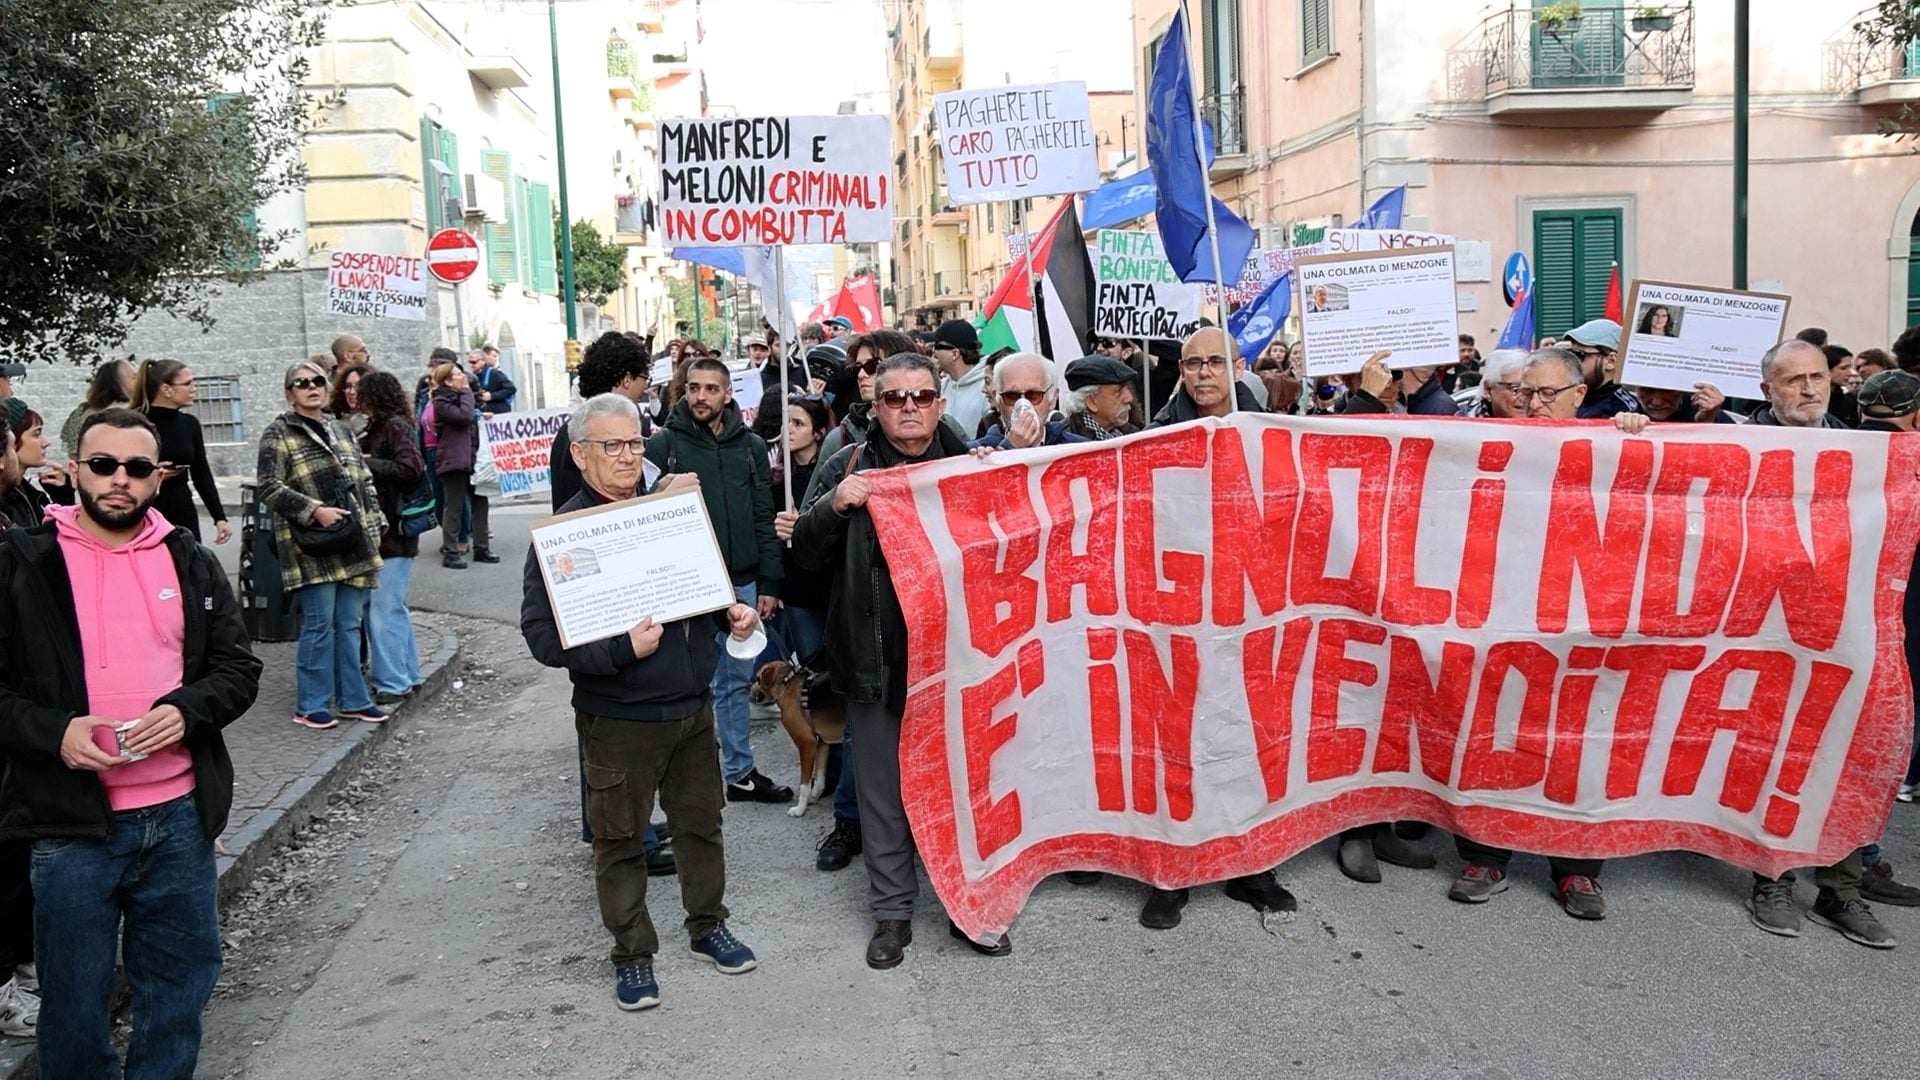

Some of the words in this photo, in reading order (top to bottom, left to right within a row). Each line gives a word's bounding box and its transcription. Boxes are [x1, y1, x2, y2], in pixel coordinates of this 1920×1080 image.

[945, 90, 1056, 128] PAGHERETE
[661, 117, 790, 164] MANFREDI
[812, 135, 827, 162] E
[948, 130, 994, 155] CARO
[1005, 119, 1090, 152] PAGHERETE
[959, 154, 1038, 188] TUTTO
[662, 165, 765, 204] MELONI
[769, 170, 887, 209] CRIMINALI
[665, 208, 696, 241] IN
[701, 207, 847, 245] COMBUTTA
[1101, 230, 1154, 256] FINTA
[1329, 232, 1359, 252] SUI
[331, 271, 335, 285] I
[332, 252, 421, 281] SOSPENDETE
[1099, 255, 1179, 284] BONIFIC
[1303, 269, 1325, 279] UNA
[1327, 264, 1376, 277] COLMATA
[1379, 263, 1388, 272] DI
[1391, 258, 1448, 271] MENZOGNE
[330, 288, 337, 298] E
[340, 289, 356, 300] POI
[358, 291, 372, 301] NE
[376, 292, 427, 307] POSSIAMO
[331, 299, 386, 318] PARLARE!
[1099, 283, 1156, 307] FINTA
[1641, 289, 1662, 299] UNA
[1663, 292, 1710, 304] COLMATA
[1712, 297, 1722, 305] DI
[1724, 298, 1781, 312] MENZOGNE
[485, 421, 514, 443] UNA
[515, 413, 571, 439] COLMAT
[525, 437, 554, 452] BONIF
[539, 534, 566, 550] UNA
[567, 521, 622, 543] COLMATA
[622, 518, 635, 529] DI
[635, 503, 698, 526] MENZOGNE
[1536, 439, 1852, 651] NON
